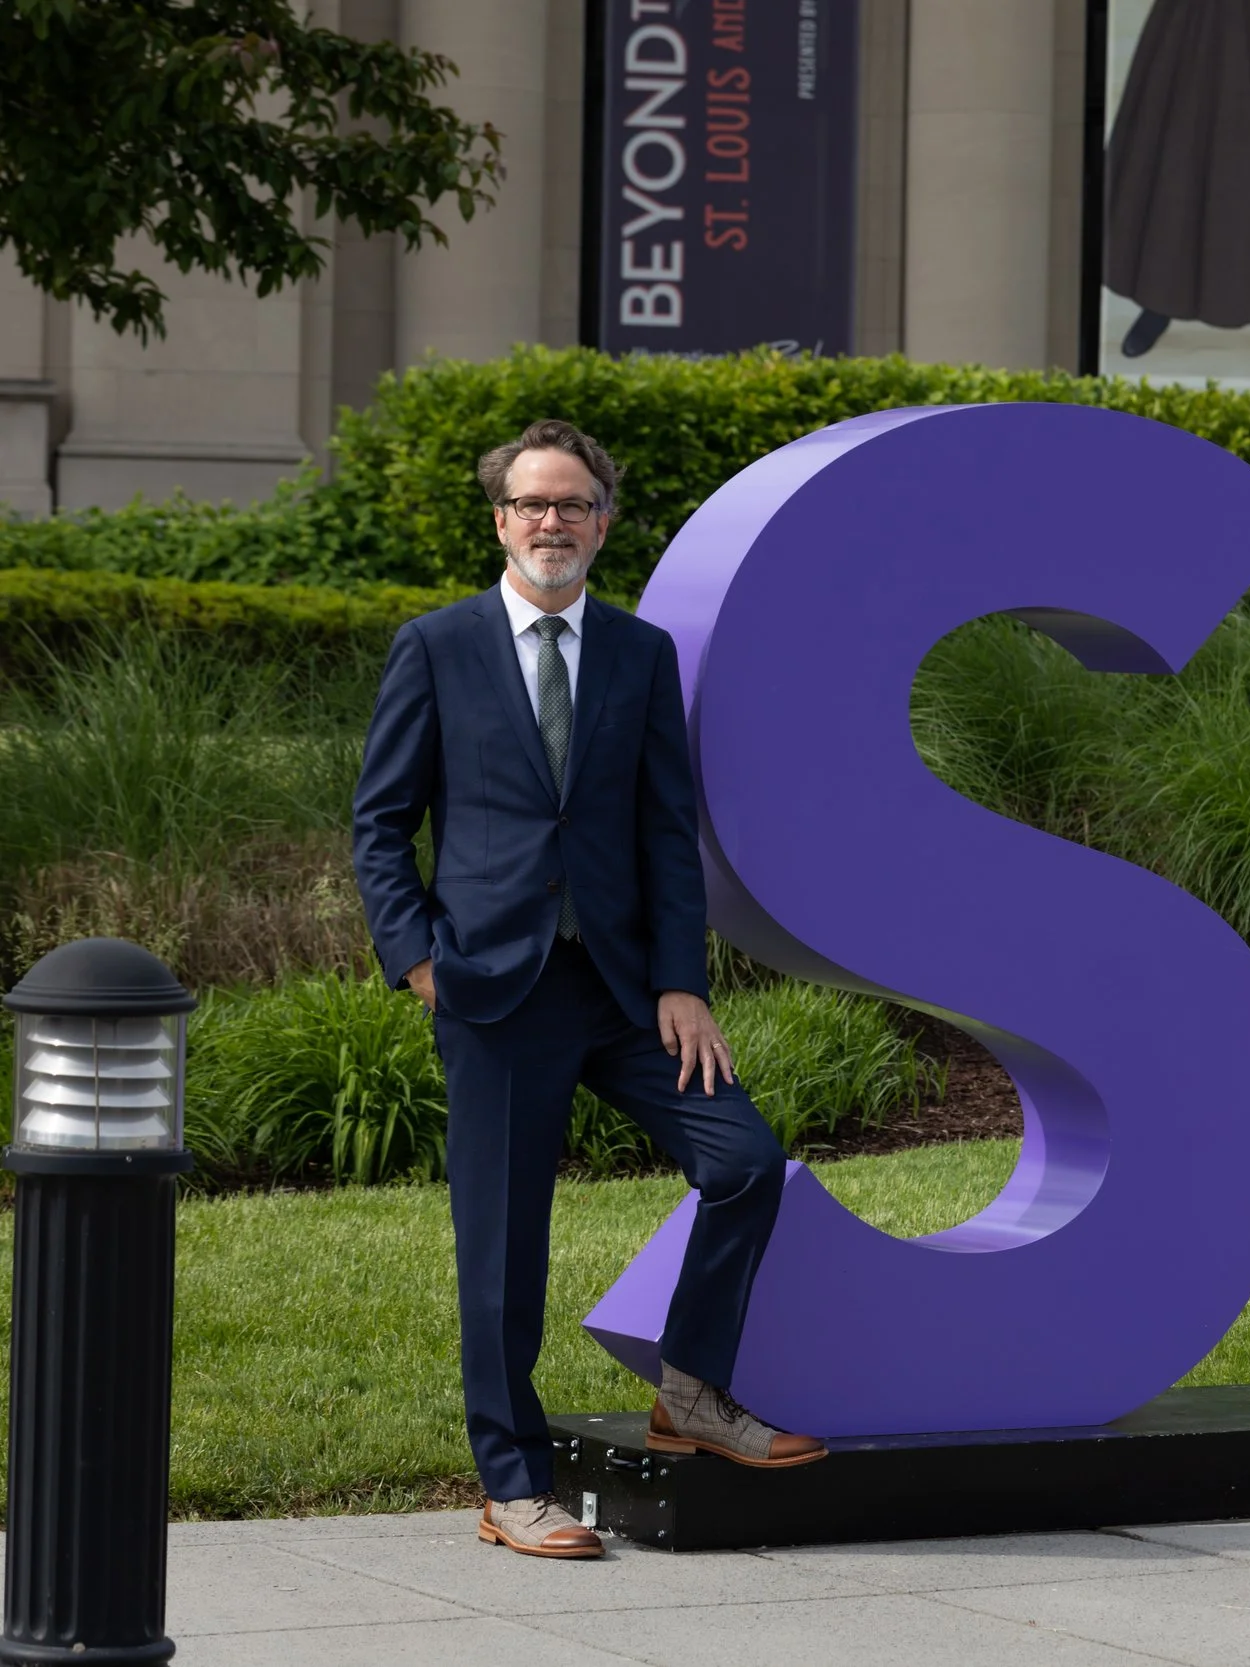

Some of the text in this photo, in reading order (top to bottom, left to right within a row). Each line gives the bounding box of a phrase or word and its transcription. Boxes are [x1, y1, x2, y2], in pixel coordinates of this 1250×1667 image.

[798, 20, 817, 100] PRESENTED
[705, 66, 752, 183] LOUIS
[620, 24, 687, 328] BEYOND
[703, 198, 750, 251] ST.
